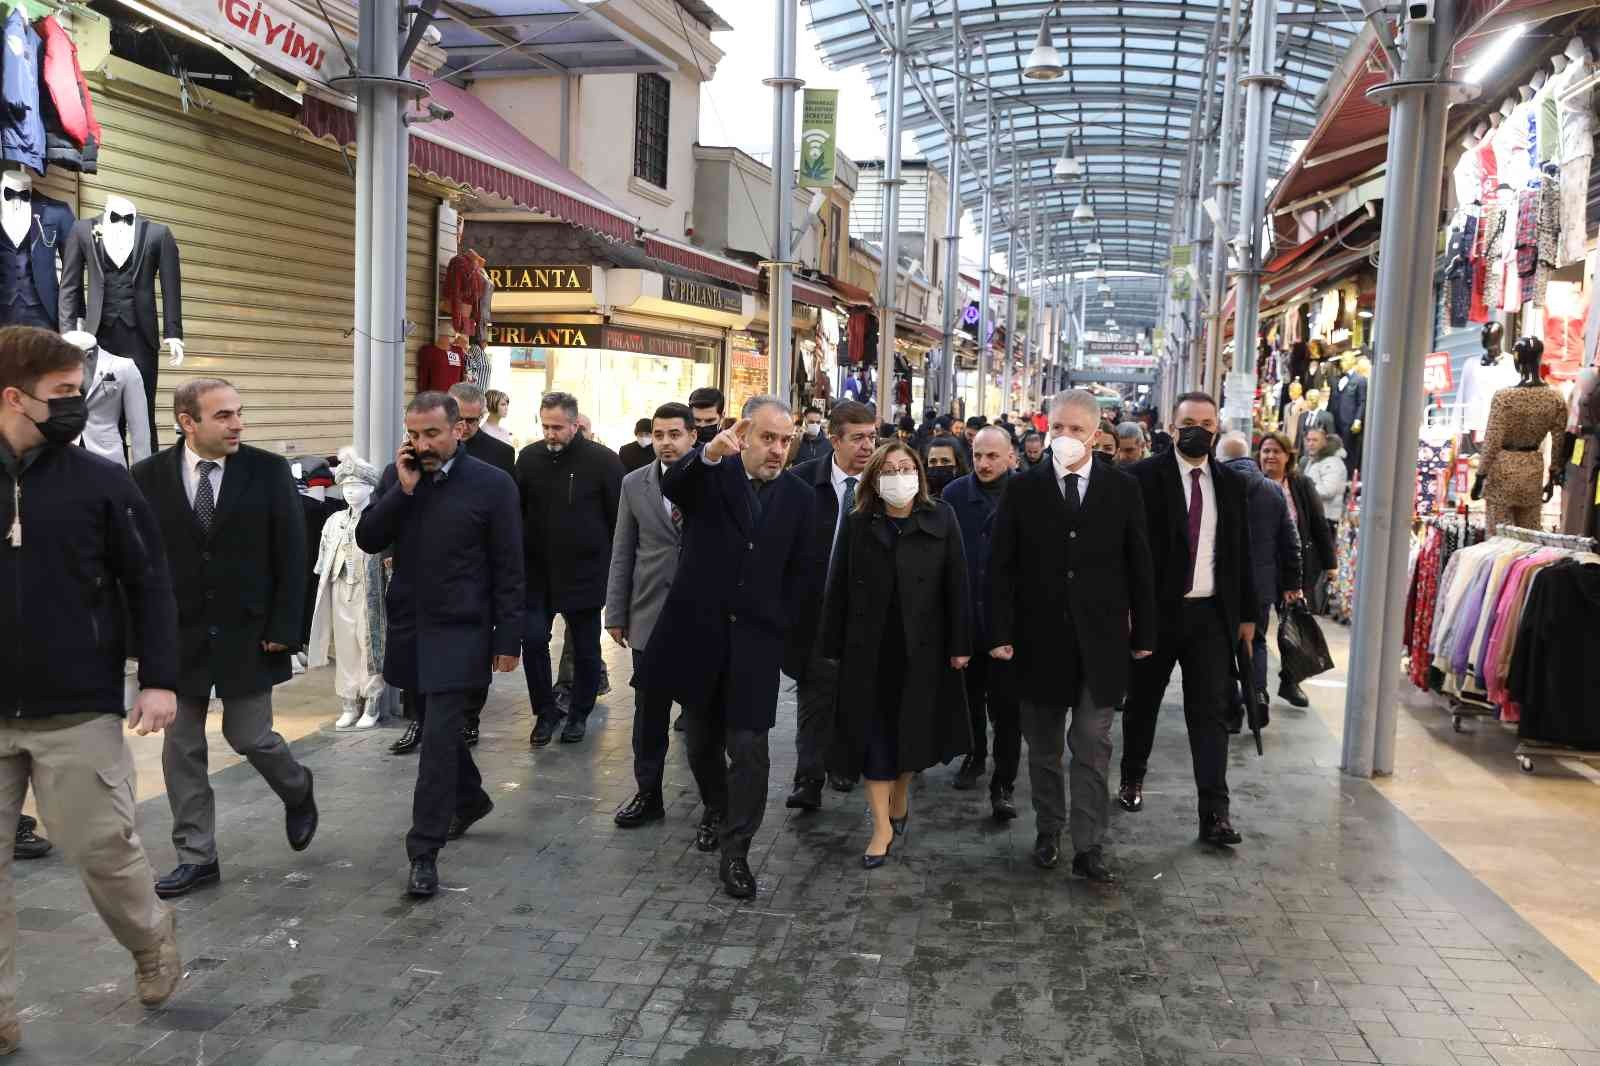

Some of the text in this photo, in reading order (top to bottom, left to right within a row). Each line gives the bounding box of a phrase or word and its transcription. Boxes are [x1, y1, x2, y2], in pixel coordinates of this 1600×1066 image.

[488, 269, 581, 288] RLANTA
[680, 279, 722, 309] PIRLANTA
[487, 327, 587, 345] PIRLANTA
